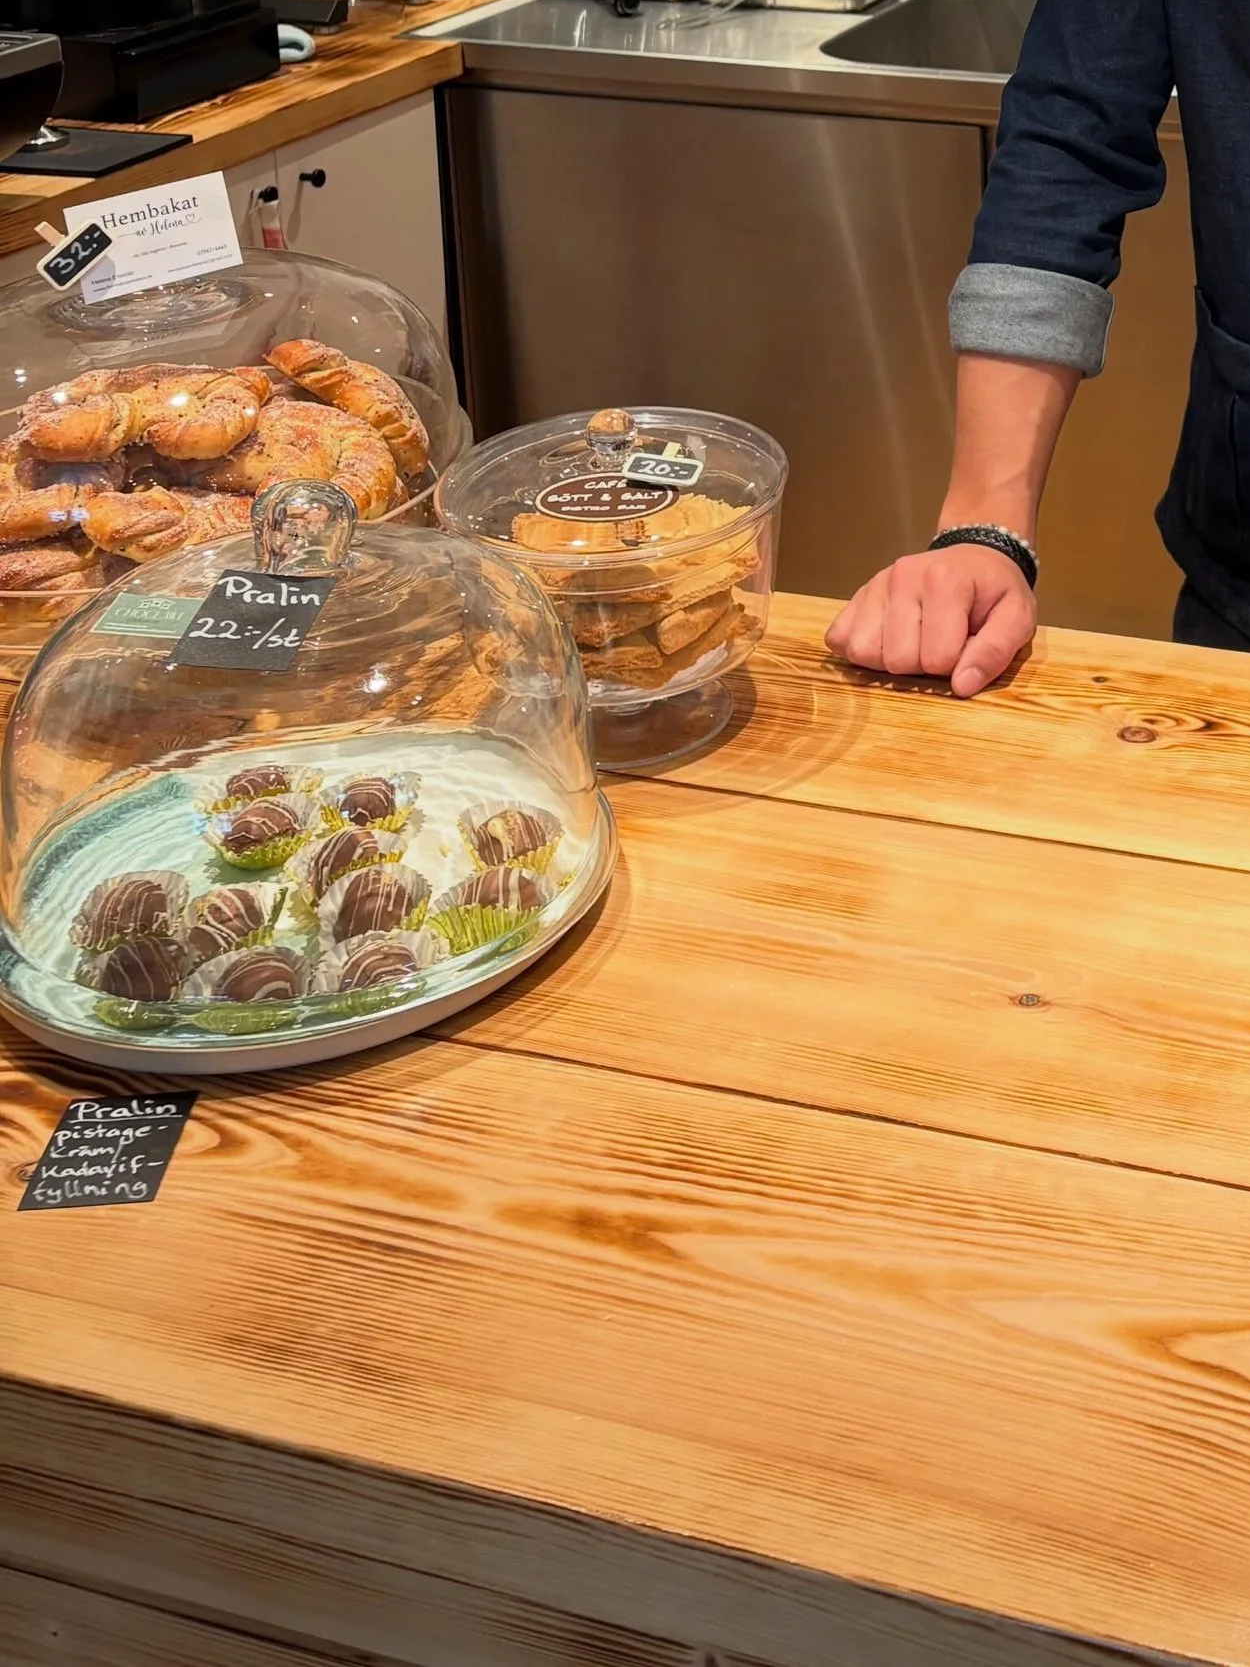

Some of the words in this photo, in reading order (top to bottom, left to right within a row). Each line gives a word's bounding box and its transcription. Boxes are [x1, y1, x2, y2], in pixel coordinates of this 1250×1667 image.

[101, 196, 200, 230] Hembakat
[217, 575, 321, 607] Pralin
[69, 1099, 178, 1121] Pralin
